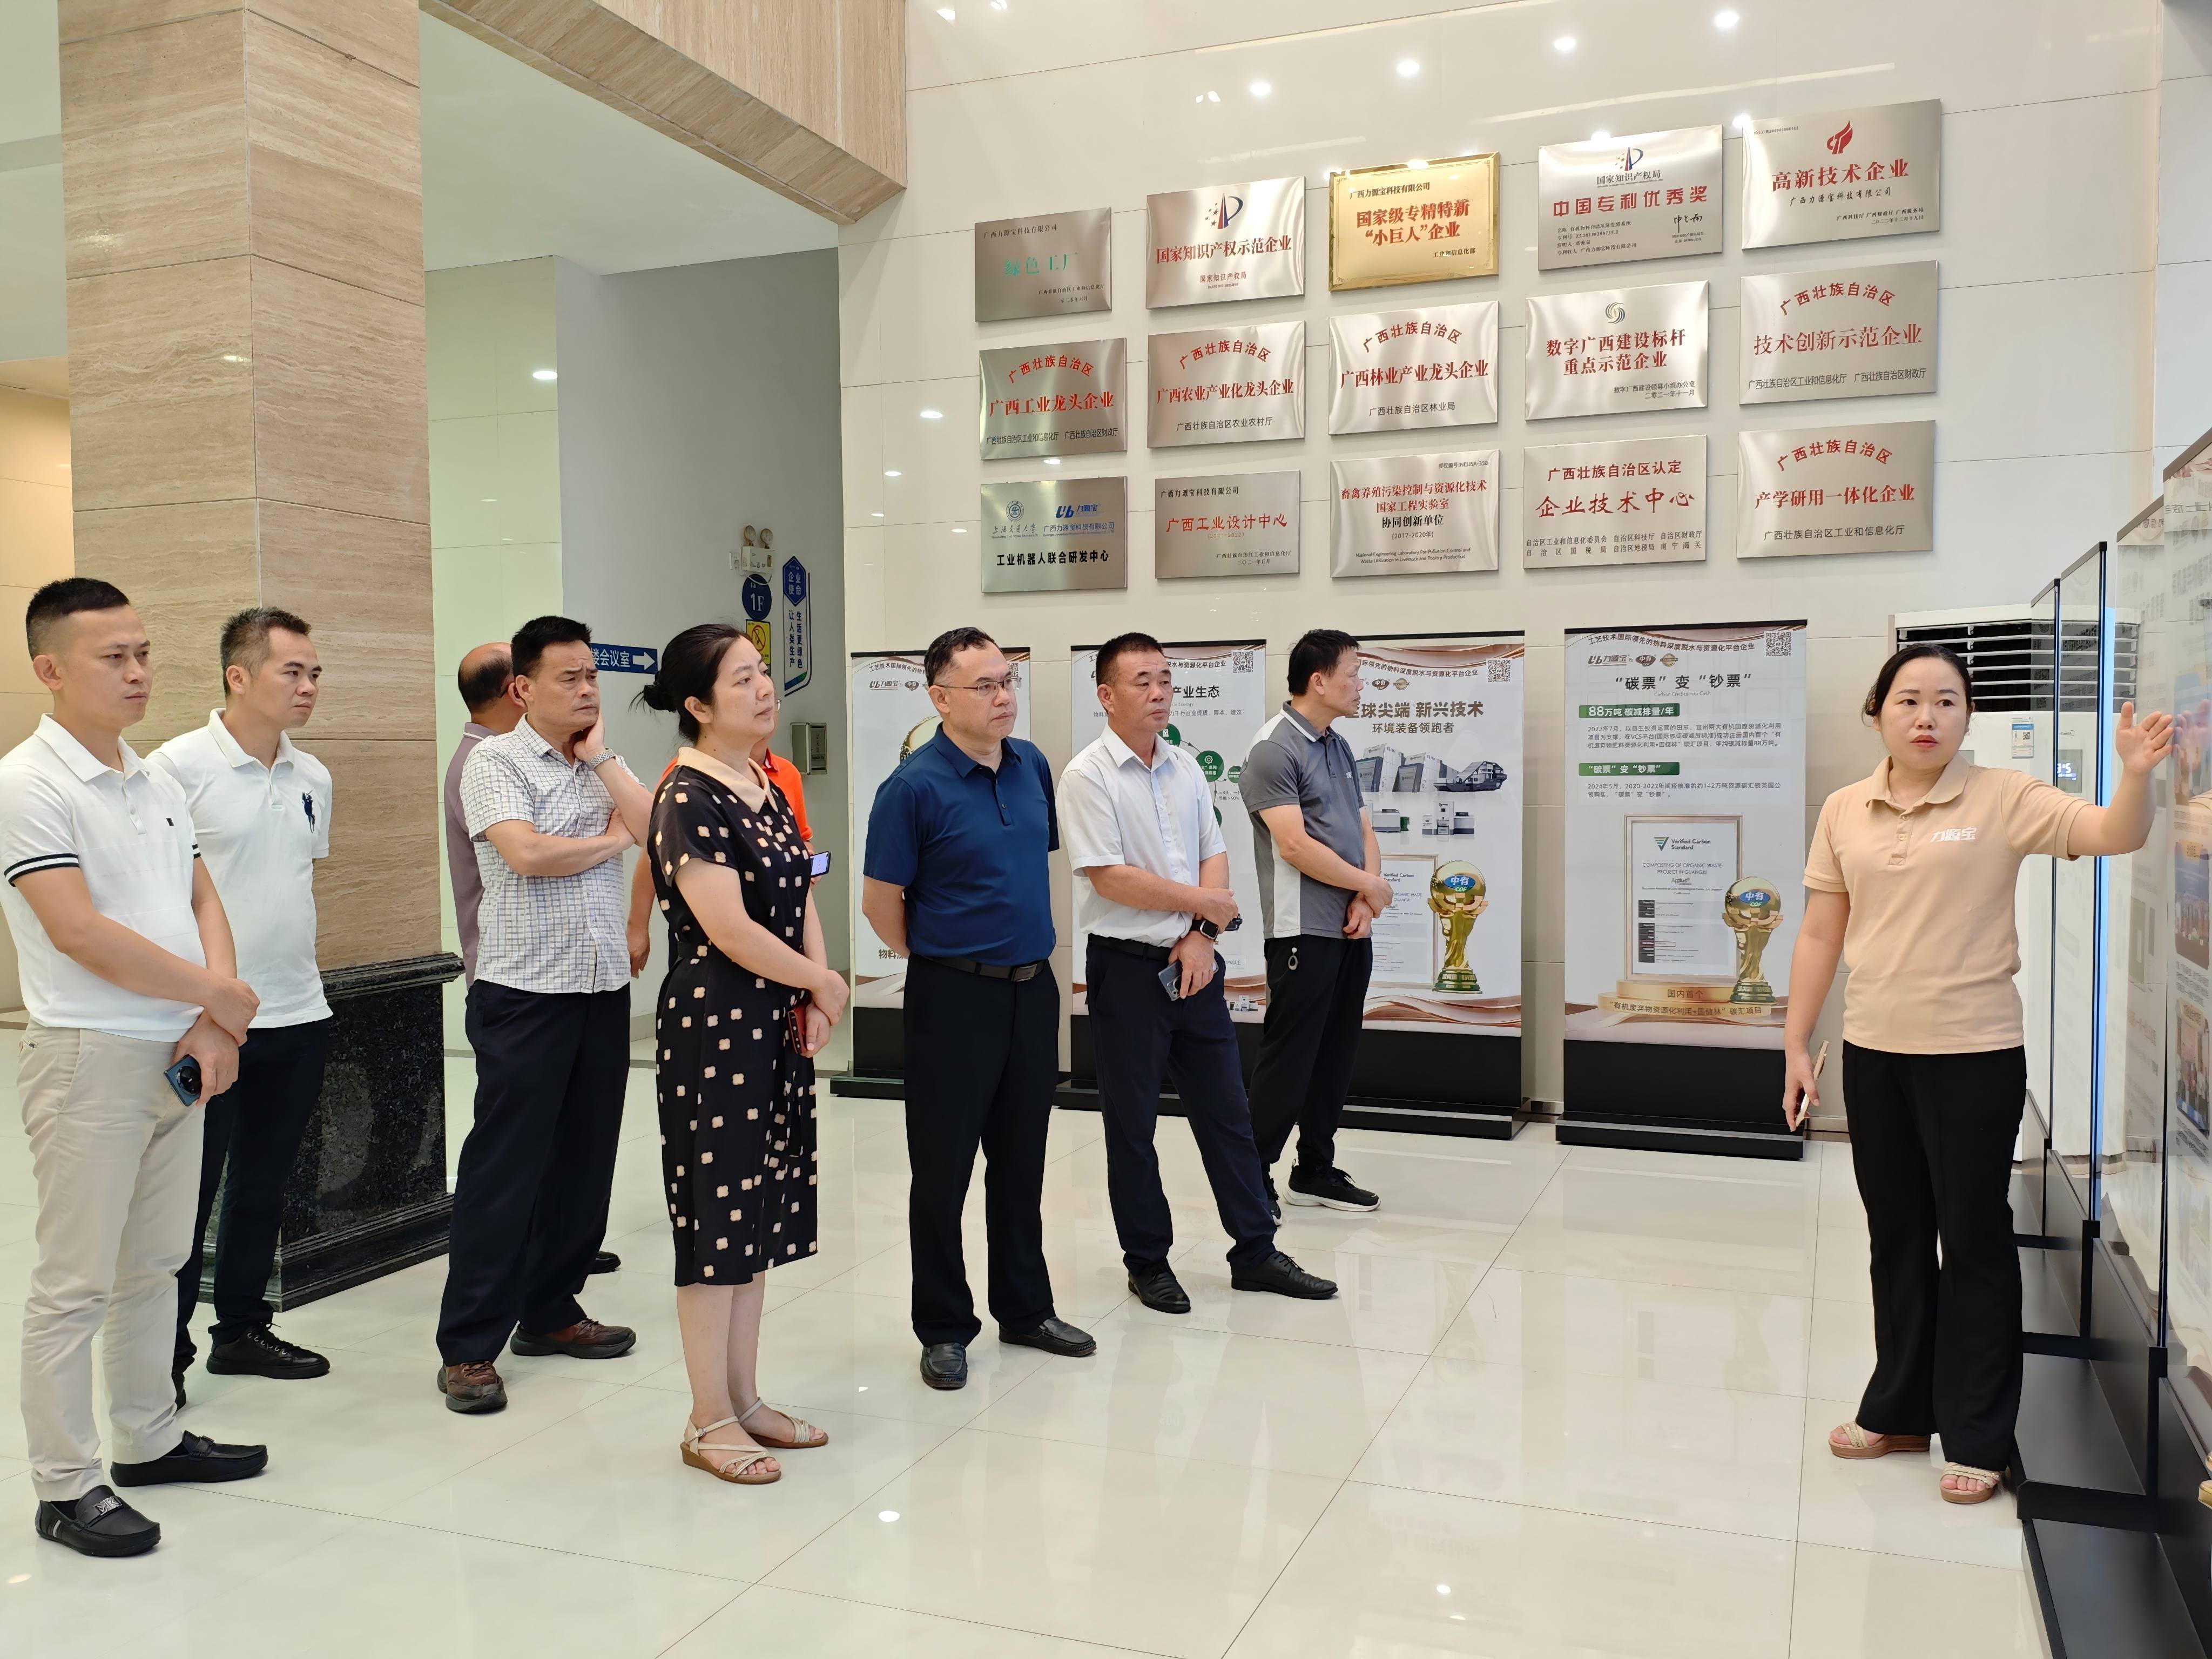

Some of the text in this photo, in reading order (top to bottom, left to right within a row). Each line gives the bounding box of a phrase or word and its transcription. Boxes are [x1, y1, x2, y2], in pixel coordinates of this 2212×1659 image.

[1596, 169, 1661, 185] 国家知识产权局
[1771, 159, 1909, 192] 高新技术企业
[1350, 181, 1431, 199] 广西力源宝科技有限公司
[1789, 187, 1891, 207] 广西力源宝科技有限公司
[1553, 185, 1708, 217] 中国专利优秀奖
[1357, 198, 1471, 228] 国家级专精特新
[984, 224, 1057, 239] 广西力源宝科技有限公司
[1365, 221, 1460, 246] “小巨人”企业
[1157, 235, 1292, 264] 国家知识产权示范企业
[1200, 271, 1246, 283] 国家知识产权局
[1780, 282, 1896, 316] 广西壮族自治区
[1363, 321, 1462, 353] 广西壮族自治区
[1546, 328, 1685, 358] 数字广西建设标杆
[1754, 323, 1922, 355] 技术创新示范企业
[1179, 340, 1271, 369] 广西壮族自治区
[1563, 350, 1668, 375] 重点示范企业
[1008, 355, 1094, 383] 广西壮族自治区
[1340, 359, 1489, 389] 广西林业产业龙头企业
[1614, 381, 1695, 394] 数字广西建设领导小组办公室
[1748, 368, 1927, 390] 广西壮族自治区工业和信息化厅 广西壮族自治区财政厅
[1157, 379, 1294, 404] 广西农业产业化龙头企业
[989, 392, 1114, 417] 广西工业龙头企业
[1368, 401, 1455, 417] 广西壮族自治区林业局
[1177, 417, 1273, 431] 广西壮族自治区农业农村厅
[987, 428, 1118, 445] 广西壮族自治区工业和信息化厅 广西壮族自治区财政厅
[1777, 439, 1893, 471] 广西壮族自治区
[1547, 460, 1682, 481] 广西壮族自治区认定
[1161, 486, 1239, 498] 广西力源宝科技有限公司
[1340, 479, 1487, 500] 畜禽养殖污染控制与资源化技术
[1755, 484, 1915, 509] 产学研用一体化企业
[1377, 498, 1449, 513] 国家工程实验室
[1534, 488, 1695, 518] 企业技术中心
[1043, 522, 1115, 532] 广西力源宝科技有限公司
[1166, 514, 1287, 532] 广西工业设计中心
[1382, 514, 1444, 529] 协同创新单位
[1392, 531, 1434, 539] (2017-2020年)
[1526, 530, 1703, 547] 自治区工业和信息化委员会 自治区科技厅 自治区财政厅
[1764, 525, 1905, 541] 广西壮族自治区工业和信息化厅
[1614, 543, 1655, 552] 自治区地税局
[996, 550, 1109, 566] 工业机器人联合研发中心
[788, 571, 801, 583] 企业
[788, 584, 801, 596] 使命
[750, 592, 765, 611] 1F
[1588, 633, 1755, 652] 工艺技术国际领先的物料深度脱水与资源化平台企业
[1415, 701, 1484, 718] 新兴技术
[1588, 706, 1674, 717] 88万吨 碳减排量/年
[1372, 722, 1454, 733] 环境装备领跑者
[1930, 826, 1977, 843] 力源宝
[1451, 876, 1469, 886] 中有
[1745, 892, 1764, 901] 中有
[1667, 989, 1704, 998] 国内首个
